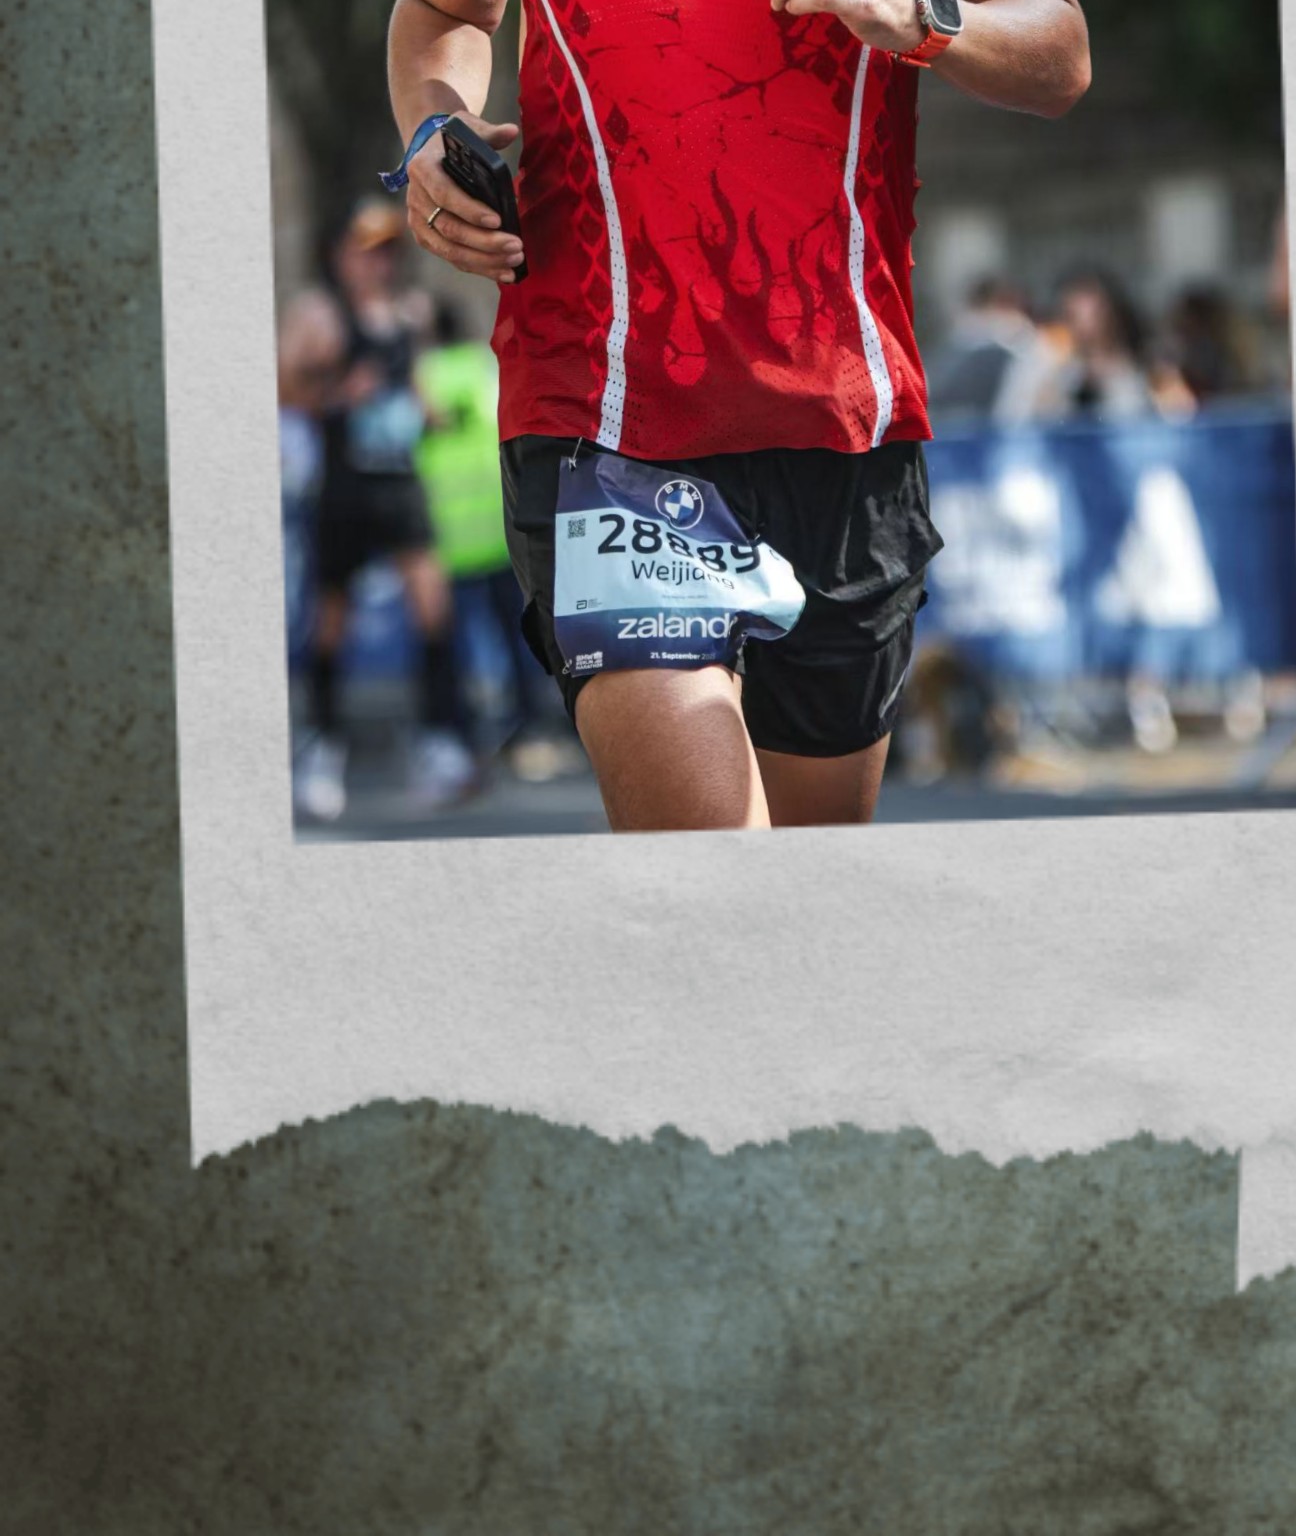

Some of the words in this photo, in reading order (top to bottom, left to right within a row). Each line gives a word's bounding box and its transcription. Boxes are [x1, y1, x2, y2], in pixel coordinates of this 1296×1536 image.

[664, 482, 700, 501] BMW
[597, 512, 761, 574] 28889
[631, 559, 736, 591] Weijiang
[617, 612, 735, 640] zaland
[650, 651, 661, 660] 21.
[661, 651, 701, 660] September
